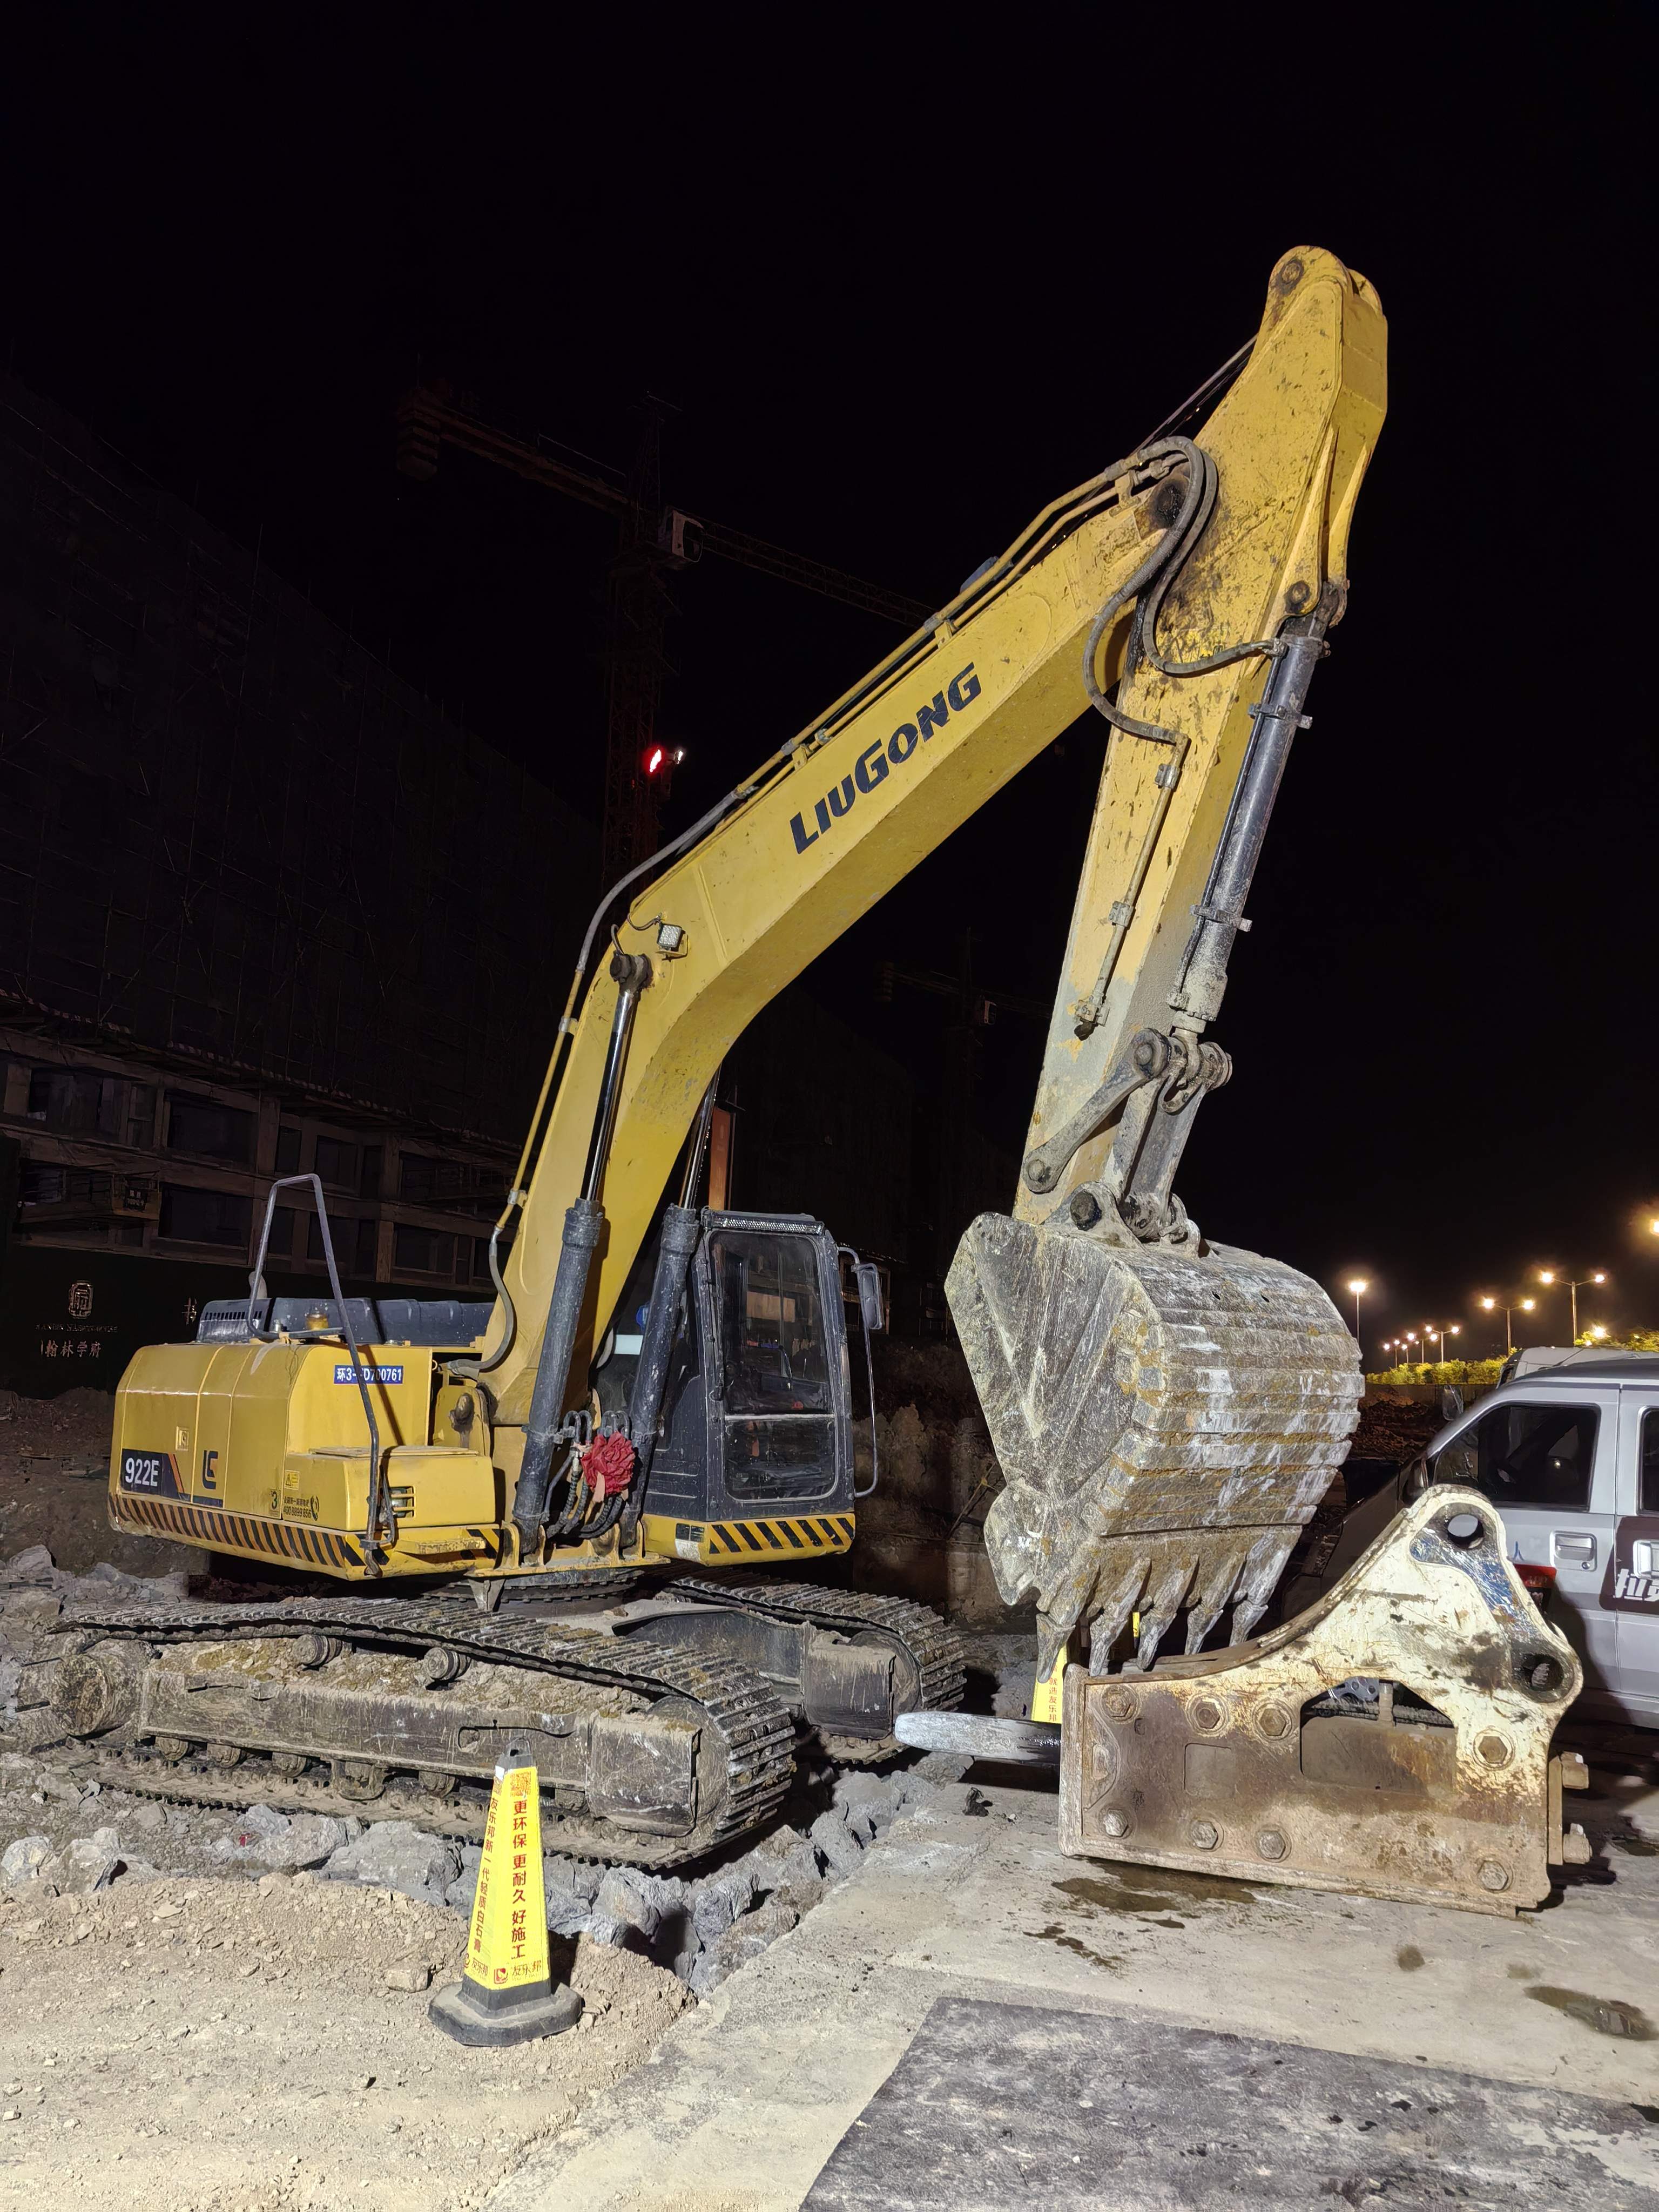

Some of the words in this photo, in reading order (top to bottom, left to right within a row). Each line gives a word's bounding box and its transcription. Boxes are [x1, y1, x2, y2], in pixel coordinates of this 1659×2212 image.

[790, 662, 982, 854] LIUGONG
[336, 1367, 402, 1382] 环3-D700761
[125, 1457, 160, 1487] 922E
[512, 1799, 528, 1850] 更环保
[512, 1853, 528, 1905] 更耐久
[511, 1909, 527, 1960] 好施工
